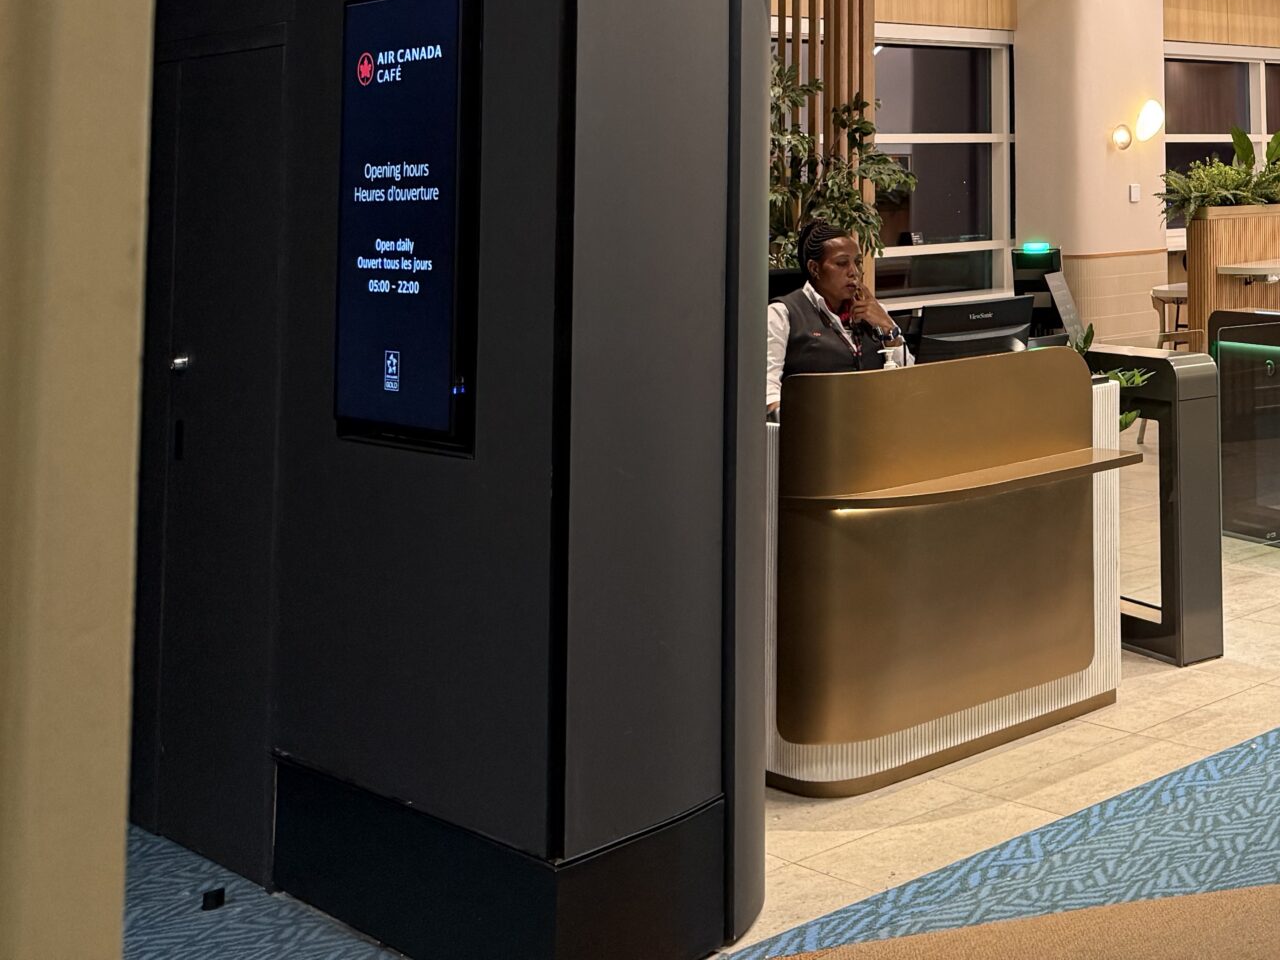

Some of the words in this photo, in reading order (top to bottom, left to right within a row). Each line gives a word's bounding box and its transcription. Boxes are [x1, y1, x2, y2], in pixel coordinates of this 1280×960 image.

[377, 51, 395, 65] AIR
[397, 45, 442, 63] CANADA
[376, 65, 402, 83] CAFÉ
[364, 162, 401, 182] Opening
[403, 161, 430, 177] hours
[354, 186, 385, 202] Heures
[387, 185, 439, 201] d'ouverture
[375, 239, 395, 254] Open
[396, 239, 414, 254] daily
[357, 257, 382, 269] Ouvert
[383, 258, 400, 270] tous
[401, 257, 412, 270] les
[413, 258, 432, 273] jours
[368, 280, 390, 293] 05:00
[398, 280, 420, 294] 22:00
